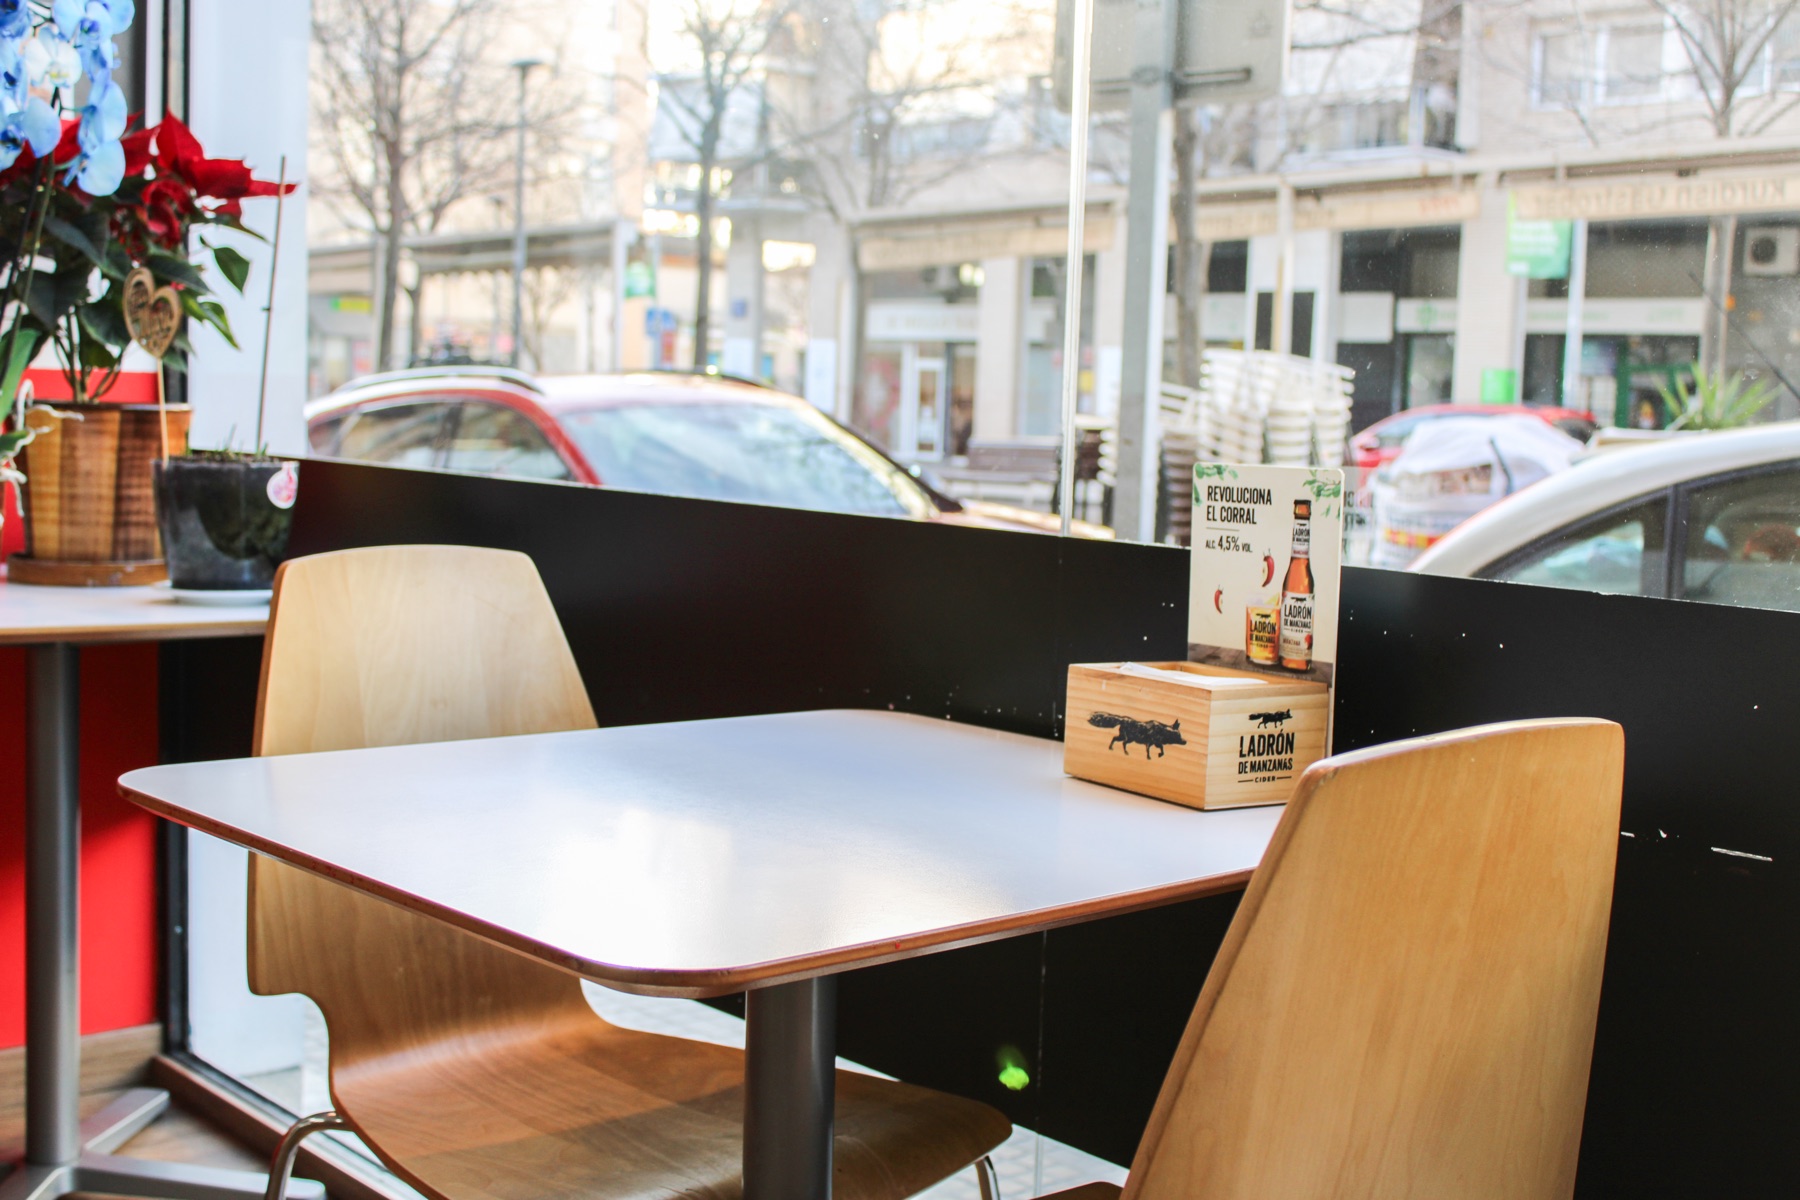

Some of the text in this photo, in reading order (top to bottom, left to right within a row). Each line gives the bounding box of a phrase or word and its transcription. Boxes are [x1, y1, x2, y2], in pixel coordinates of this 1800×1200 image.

[1207, 485, 1272, 505] REVOLUCIONA
[1206, 505, 1257, 525] EL CORRAL
[1217, 535, 1240, 552] 4,5%
[1284, 603, 1312, 619] LADRÓN
[1239, 729, 1295, 758] LADRÓN
[1238, 758, 1293, 774] DE MANZANAS
[1254, 775, 1276, 783] CIDER
